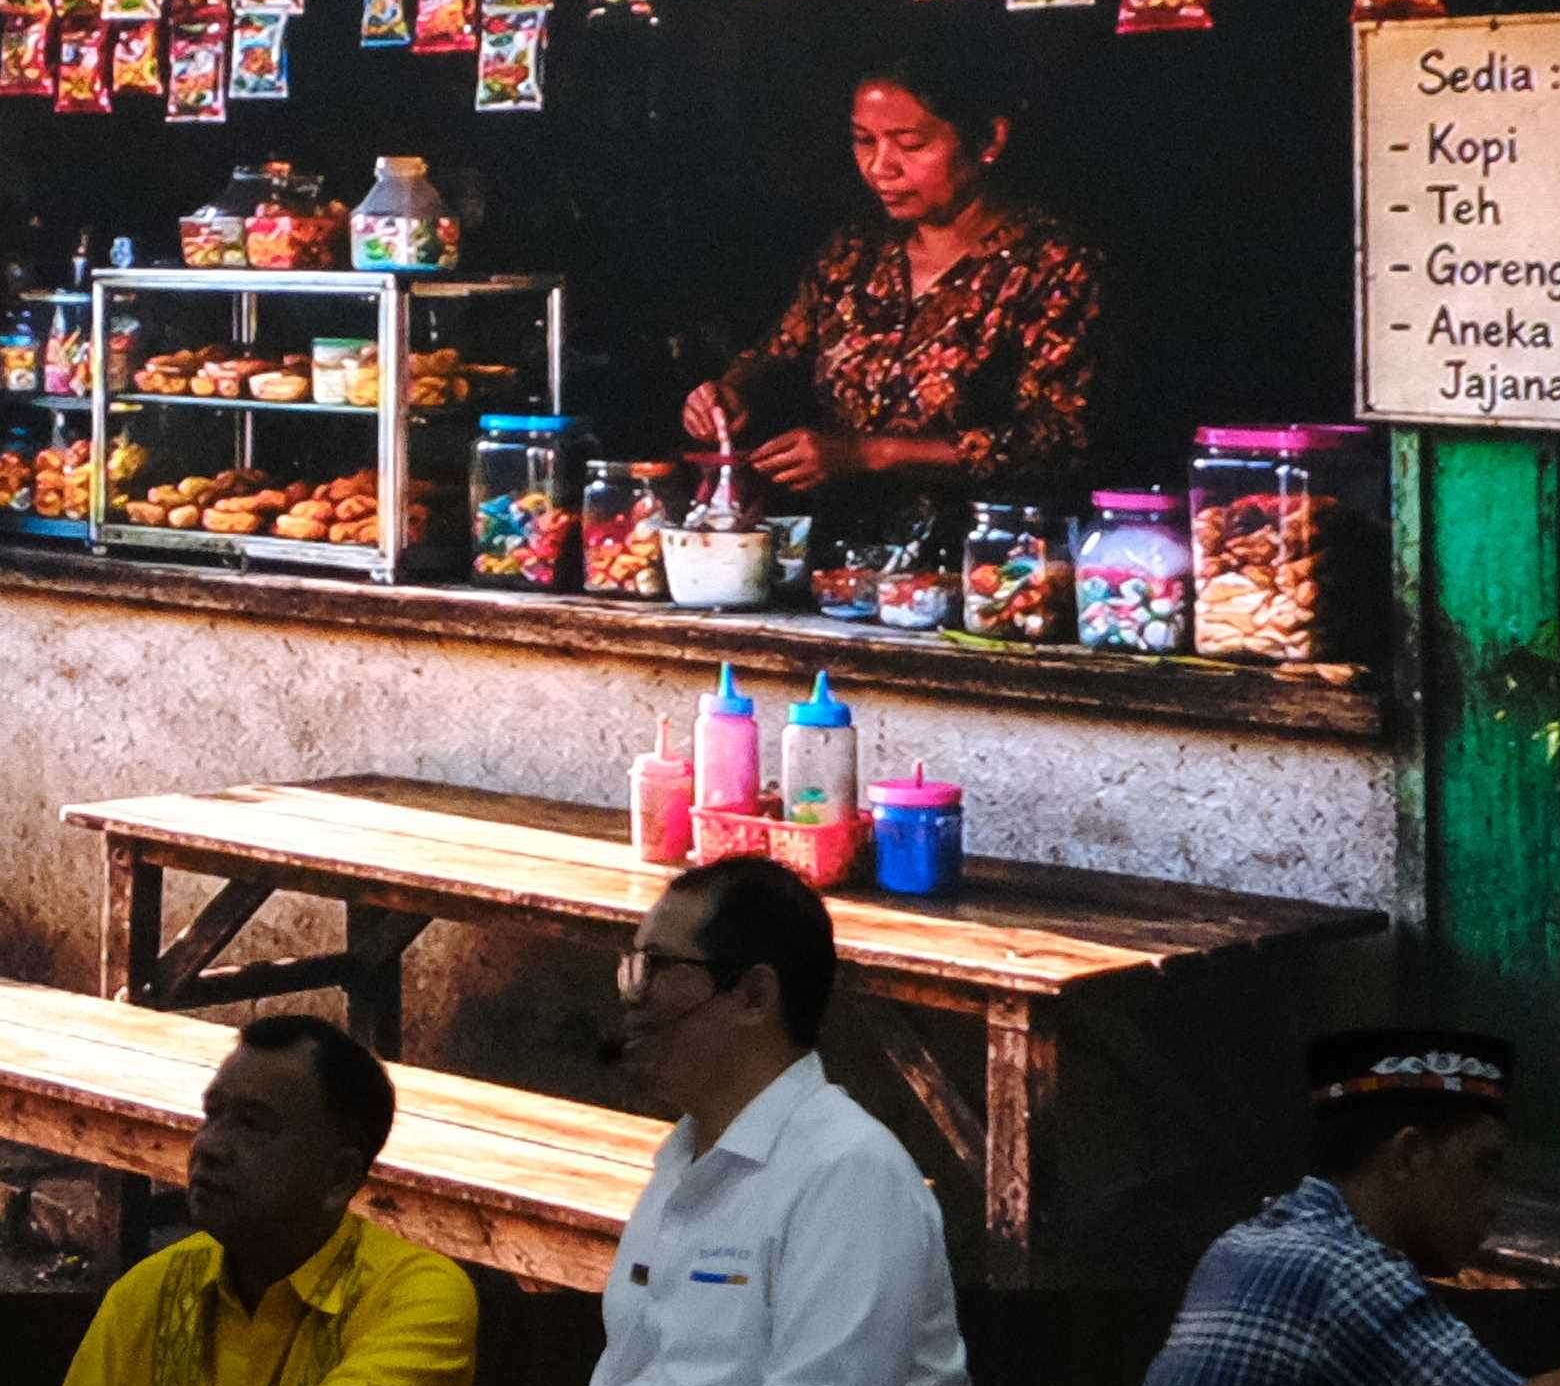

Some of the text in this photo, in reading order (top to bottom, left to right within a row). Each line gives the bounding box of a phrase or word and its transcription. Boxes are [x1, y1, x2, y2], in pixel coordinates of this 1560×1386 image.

[1417, 49, 1534, 96] Sedia
[1428, 122, 1517, 177] Kopi
[1425, 185, 1501, 225] Teh
[1427, 307, 1552, 348] Aneka
